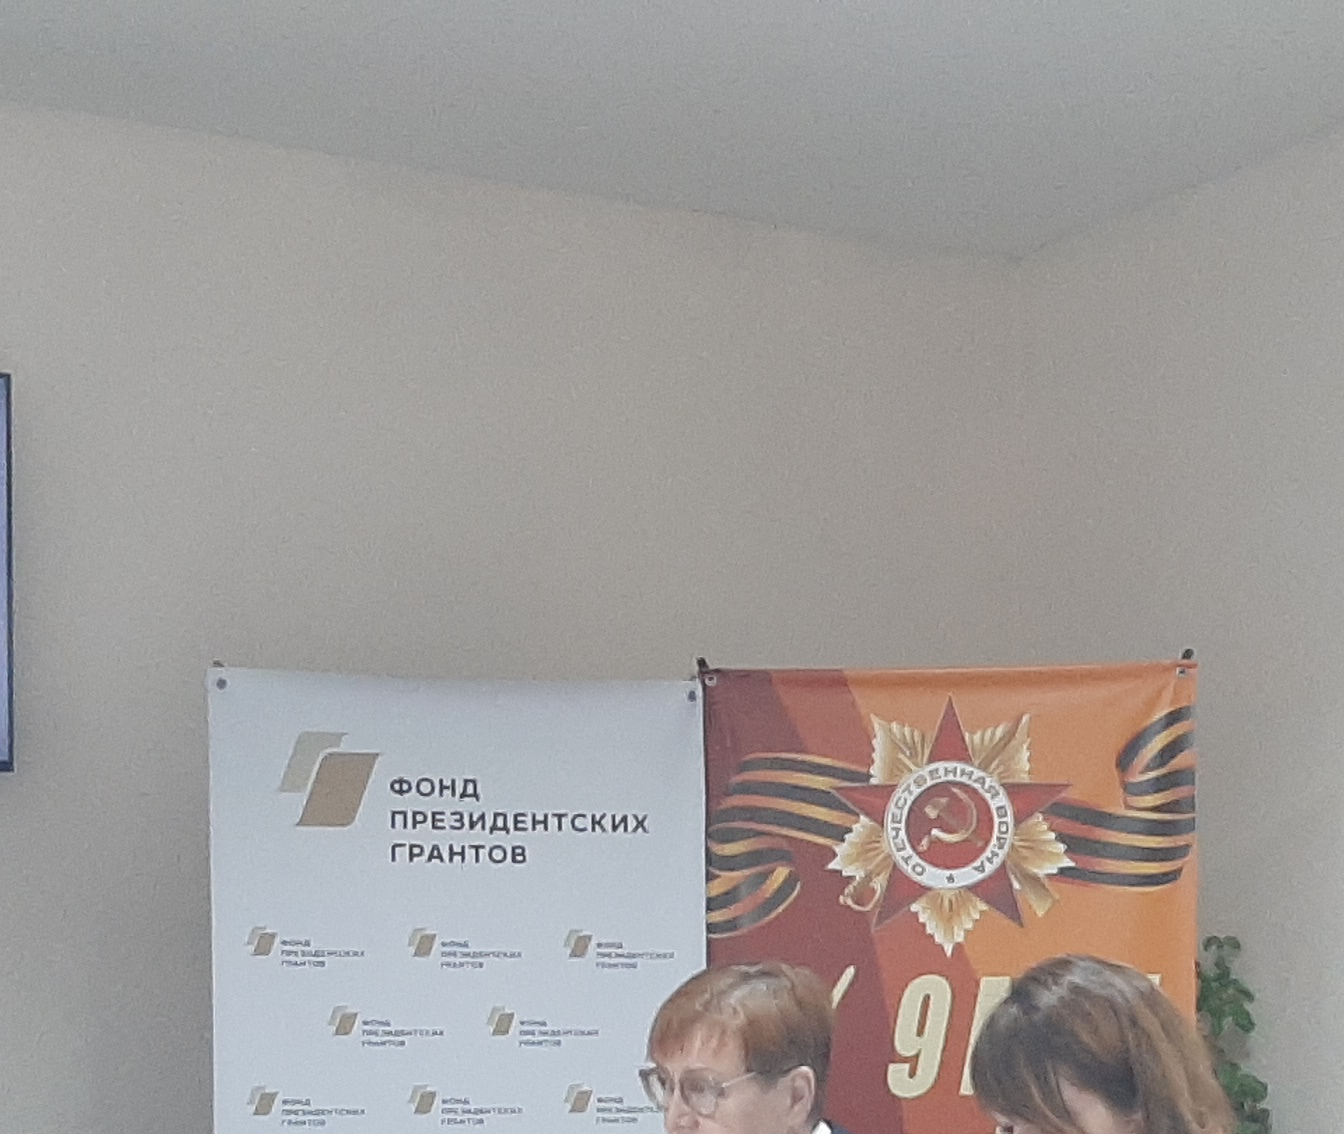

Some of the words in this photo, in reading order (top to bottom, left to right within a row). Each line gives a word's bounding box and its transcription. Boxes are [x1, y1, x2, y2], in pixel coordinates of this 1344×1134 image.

[389, 777, 480, 802] ФОНД
[389, 810, 650, 836] ПРЕЗИДЕНТСКИХ
[889, 765, 1001, 877] ОТЕЧЕСТВЕННАЯ
[971, 803, 1010, 875] ВОЙНА
[389, 843, 528, 864] ГРАНТОВ
[886, 973, 954, 1099] 9
